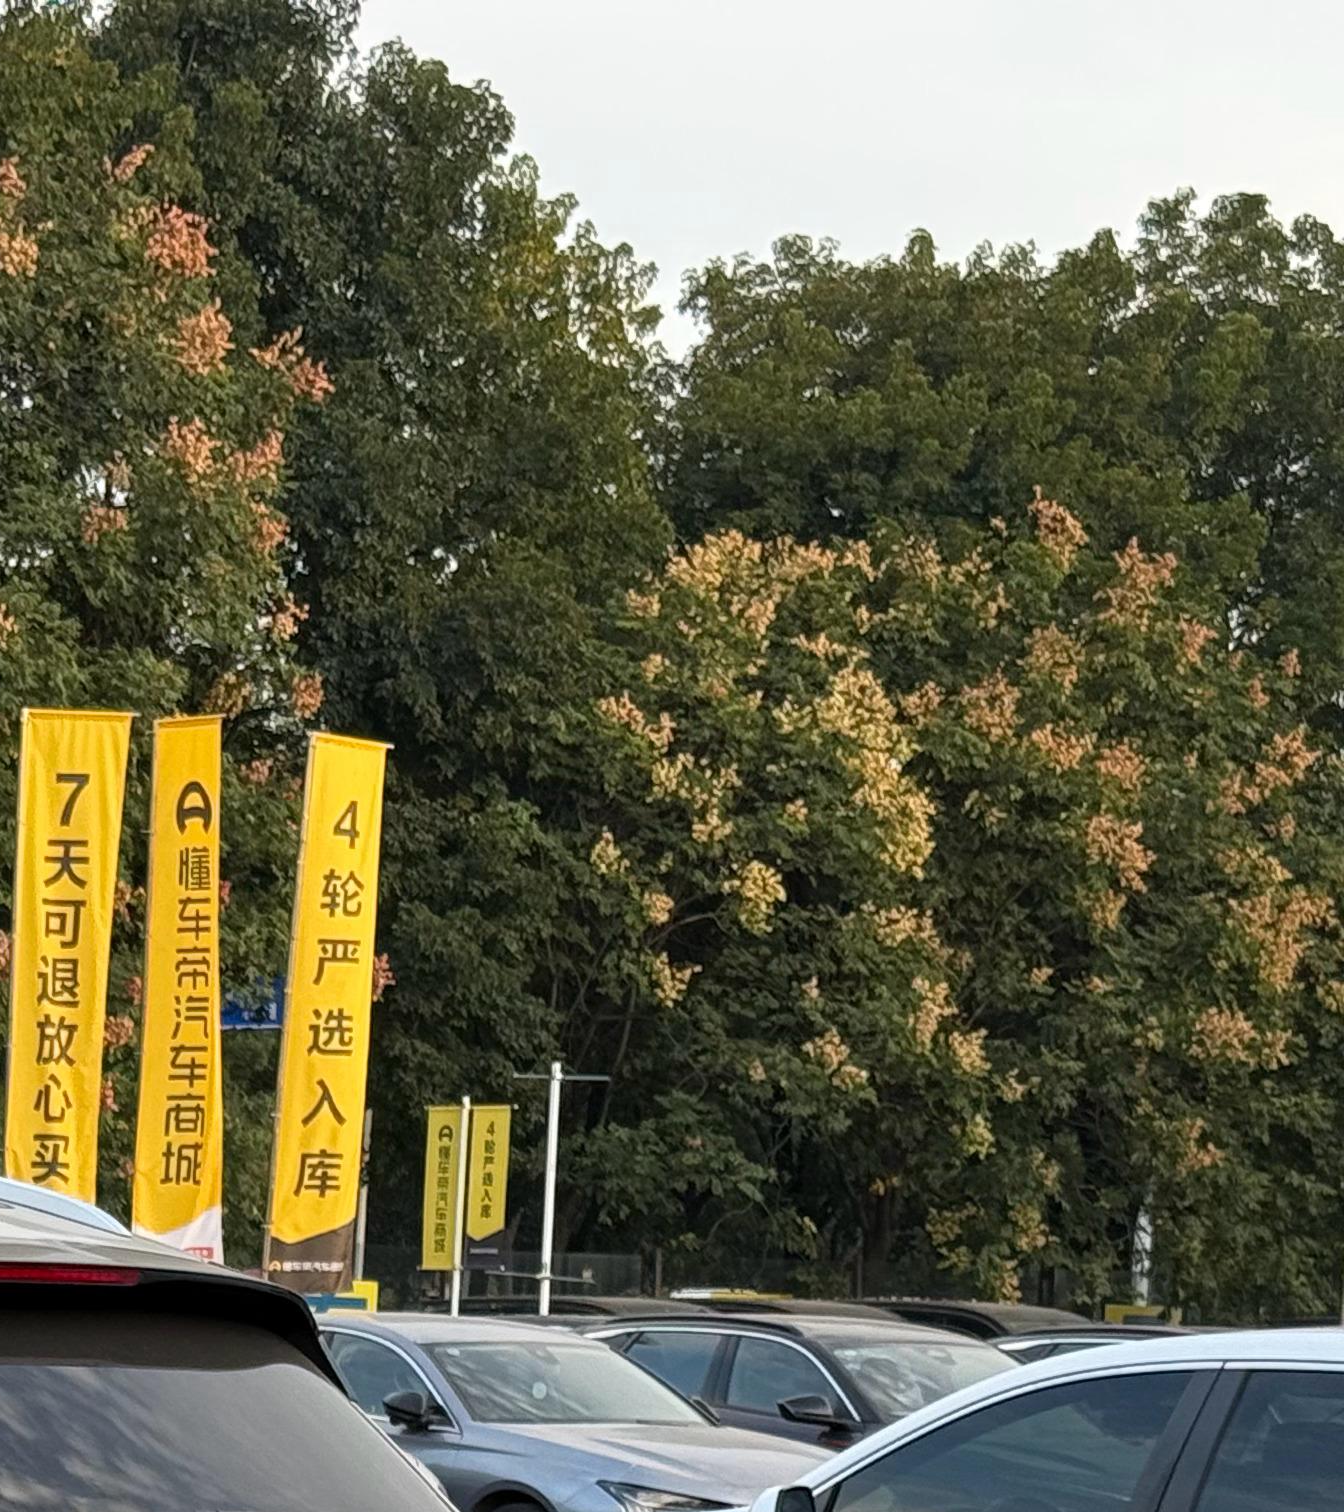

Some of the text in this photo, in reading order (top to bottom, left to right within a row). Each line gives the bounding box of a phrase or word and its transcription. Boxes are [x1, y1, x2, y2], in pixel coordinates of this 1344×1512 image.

[30, 773, 91, 1186] 7天可退放心买
[159, 846, 213, 1187] 懂车帝汽车商城
[293, 800, 366, 1199] 4轮严选入库
